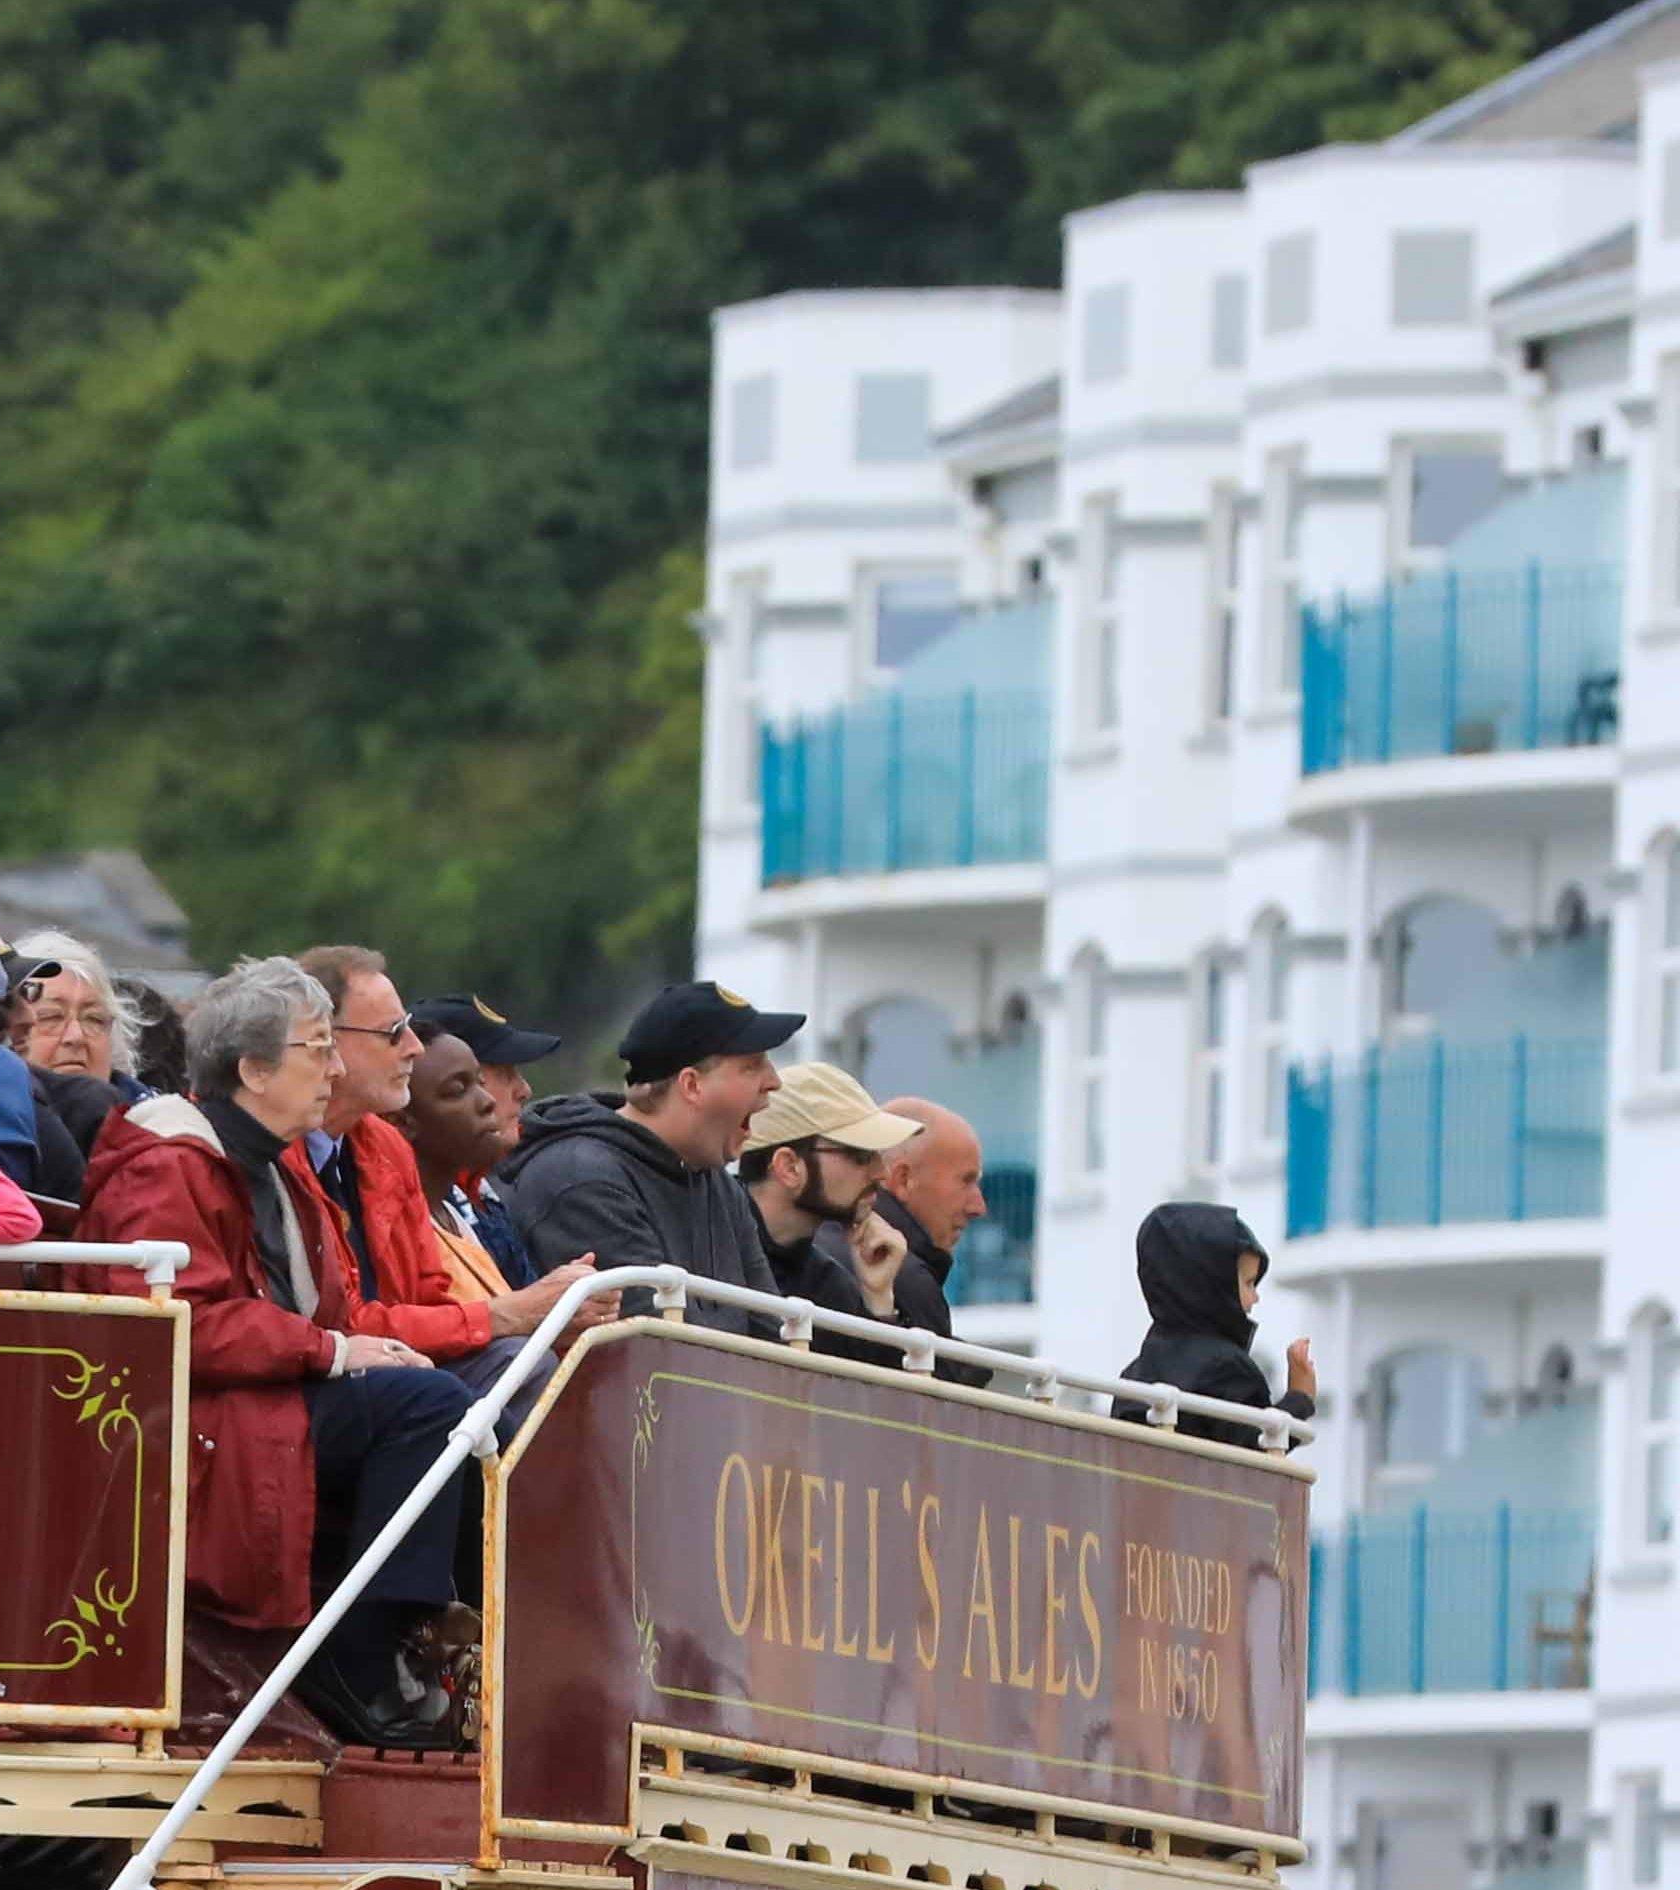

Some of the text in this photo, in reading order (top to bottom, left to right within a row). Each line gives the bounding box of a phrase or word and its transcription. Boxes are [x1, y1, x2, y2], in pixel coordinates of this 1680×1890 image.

[714, 1451, 1104, 1700] OKELL'S ALES
[1124, 1541, 1231, 1636] FOUNDED
[1138, 1637, 1219, 1726] IN 1850
